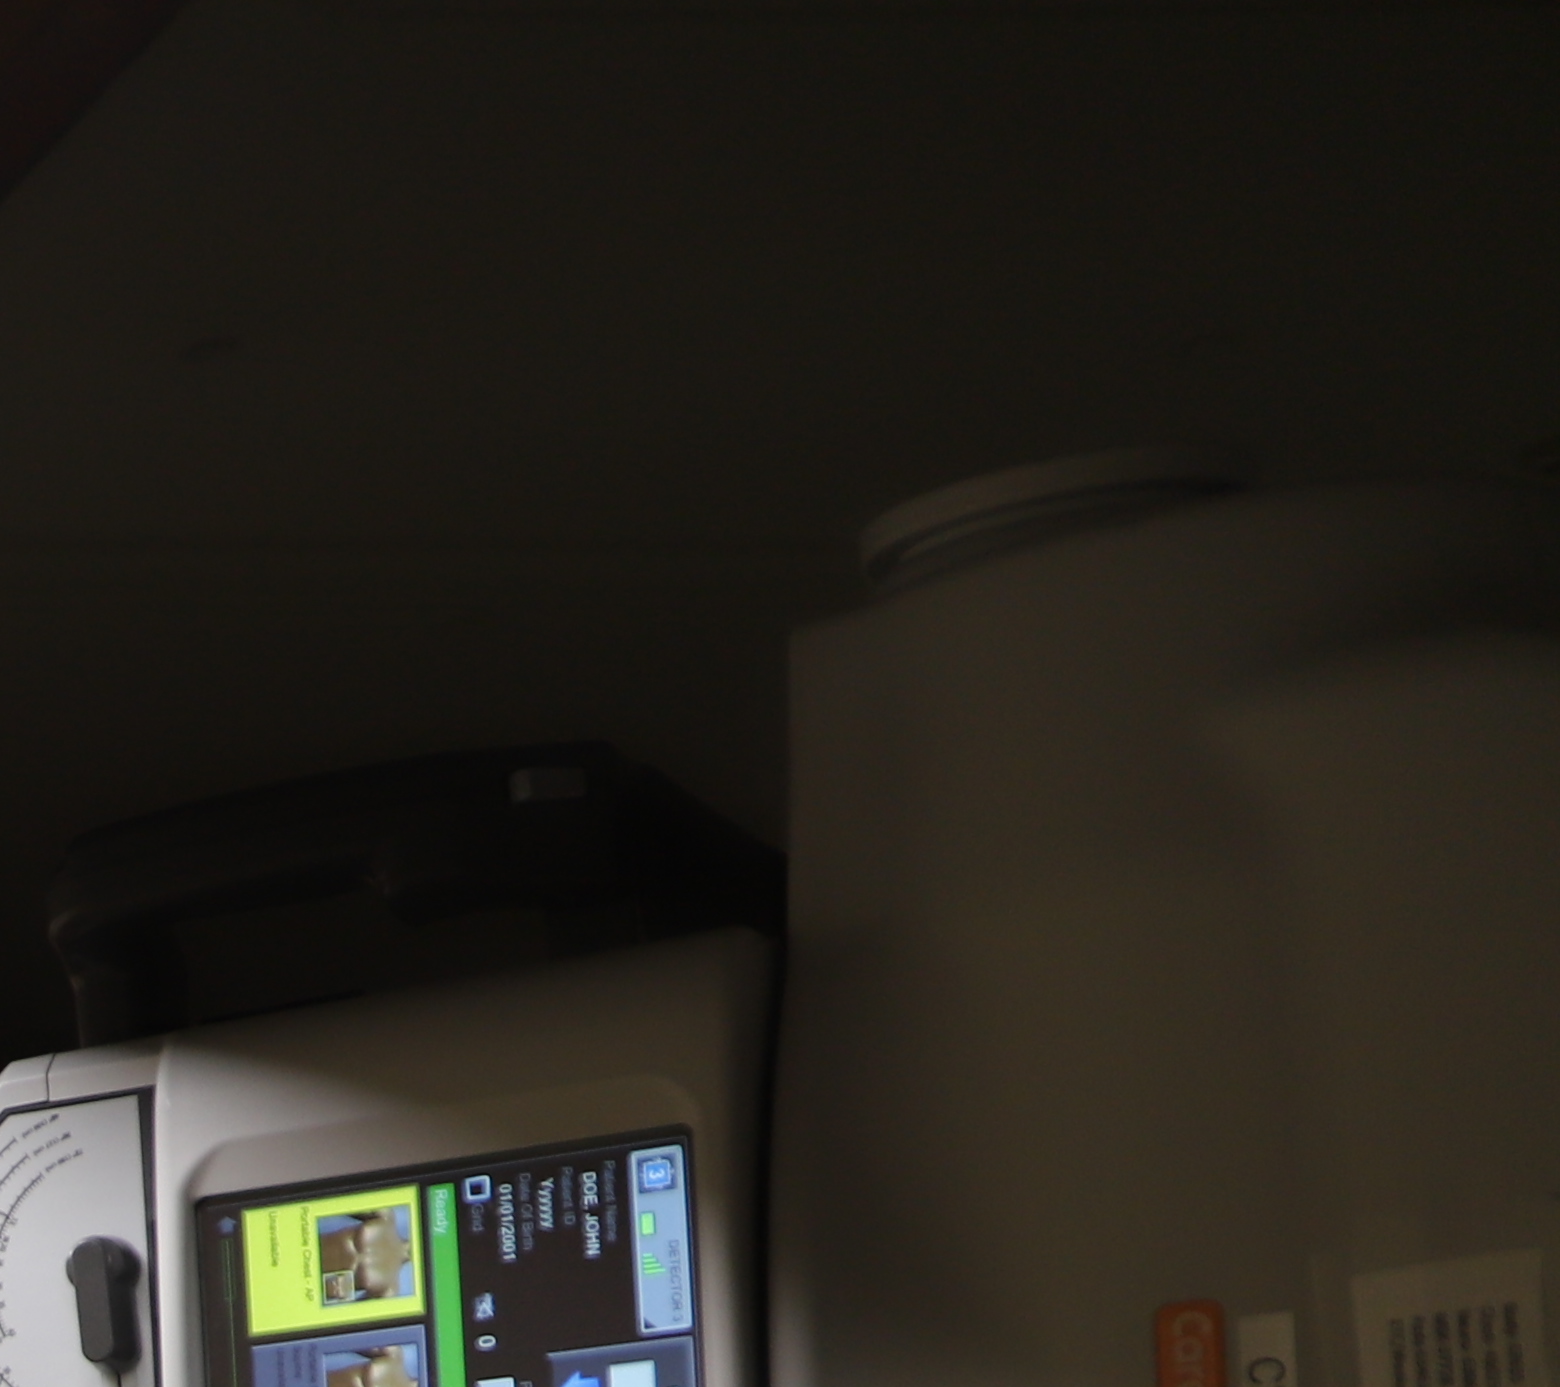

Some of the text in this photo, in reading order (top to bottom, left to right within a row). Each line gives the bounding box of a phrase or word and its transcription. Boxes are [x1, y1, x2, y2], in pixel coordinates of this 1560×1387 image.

[299, 1206, 313, 1246] Portable
[433, 1189, 449, 1233] Ready
[499, 1184, 517, 1261] 01/01/2001
[563, 1212, 575, 1225] ID
[268, 1211, 281, 1267] Unavailable
[523, 1223, 534, 1250] Birth
[585, 1213, 600, 1256] JOHN
[302, 1249, 314, 1278] Chest
[668, 1240, 683, 1311] DETECTOR
[304, 1287, 314, 1301] AP
